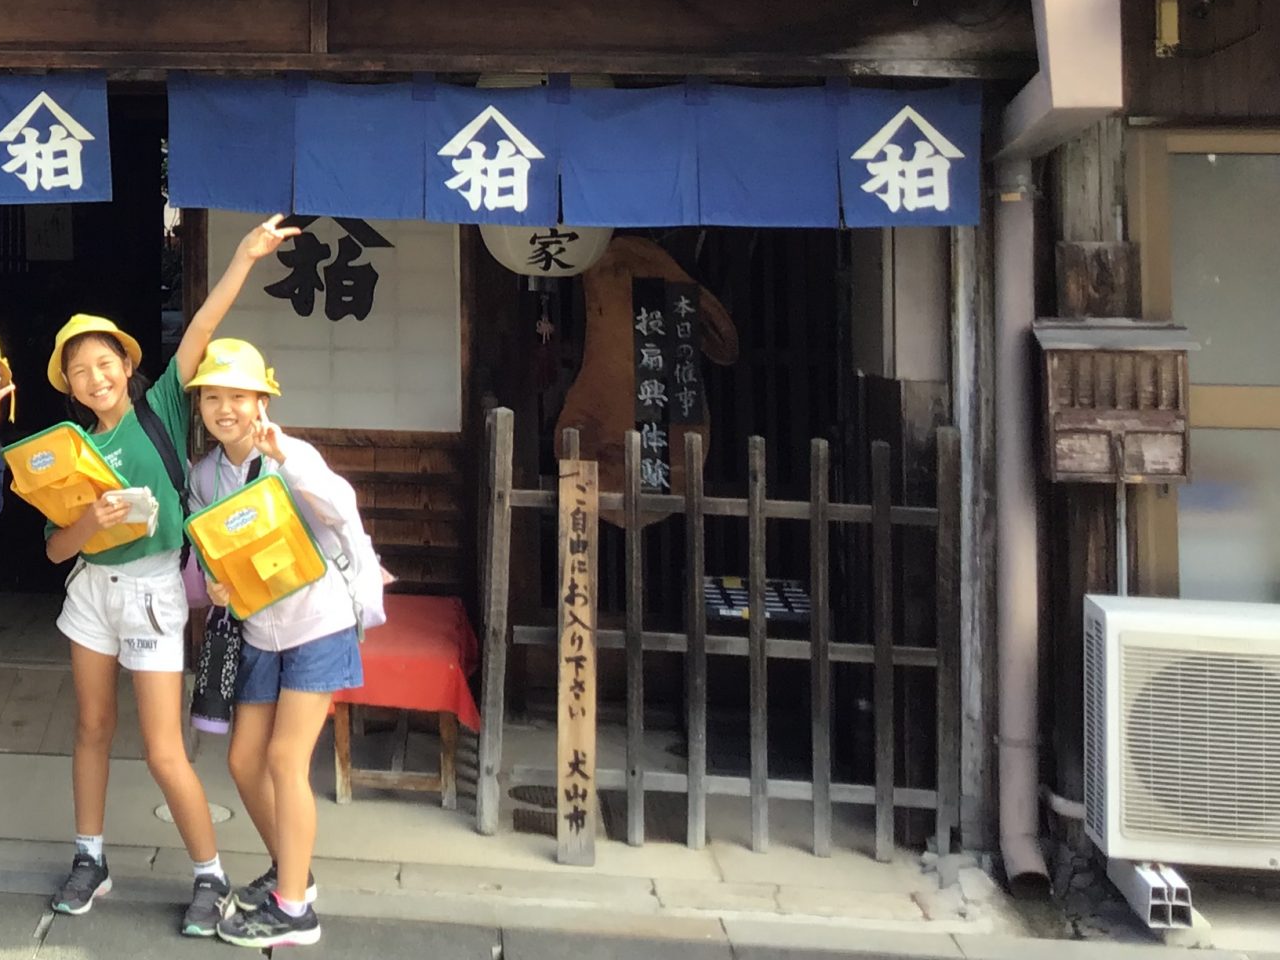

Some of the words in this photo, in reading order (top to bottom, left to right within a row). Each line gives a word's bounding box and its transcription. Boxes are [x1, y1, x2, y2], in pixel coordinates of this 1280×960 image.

[2, 126, 84, 192] 柏
[447, 140, 531, 213] 柏
[861, 142, 951, 213] 柏
[264, 233, 381, 322] 柏
[529, 231, 574, 272] 家
[635, 307, 670, 489] 投扇興体験
[673, 295, 697, 418] 本日の催事
[564, 480, 593, 719] ご自由にお入り下さい
[564, 749, 591, 832] 犬山市
